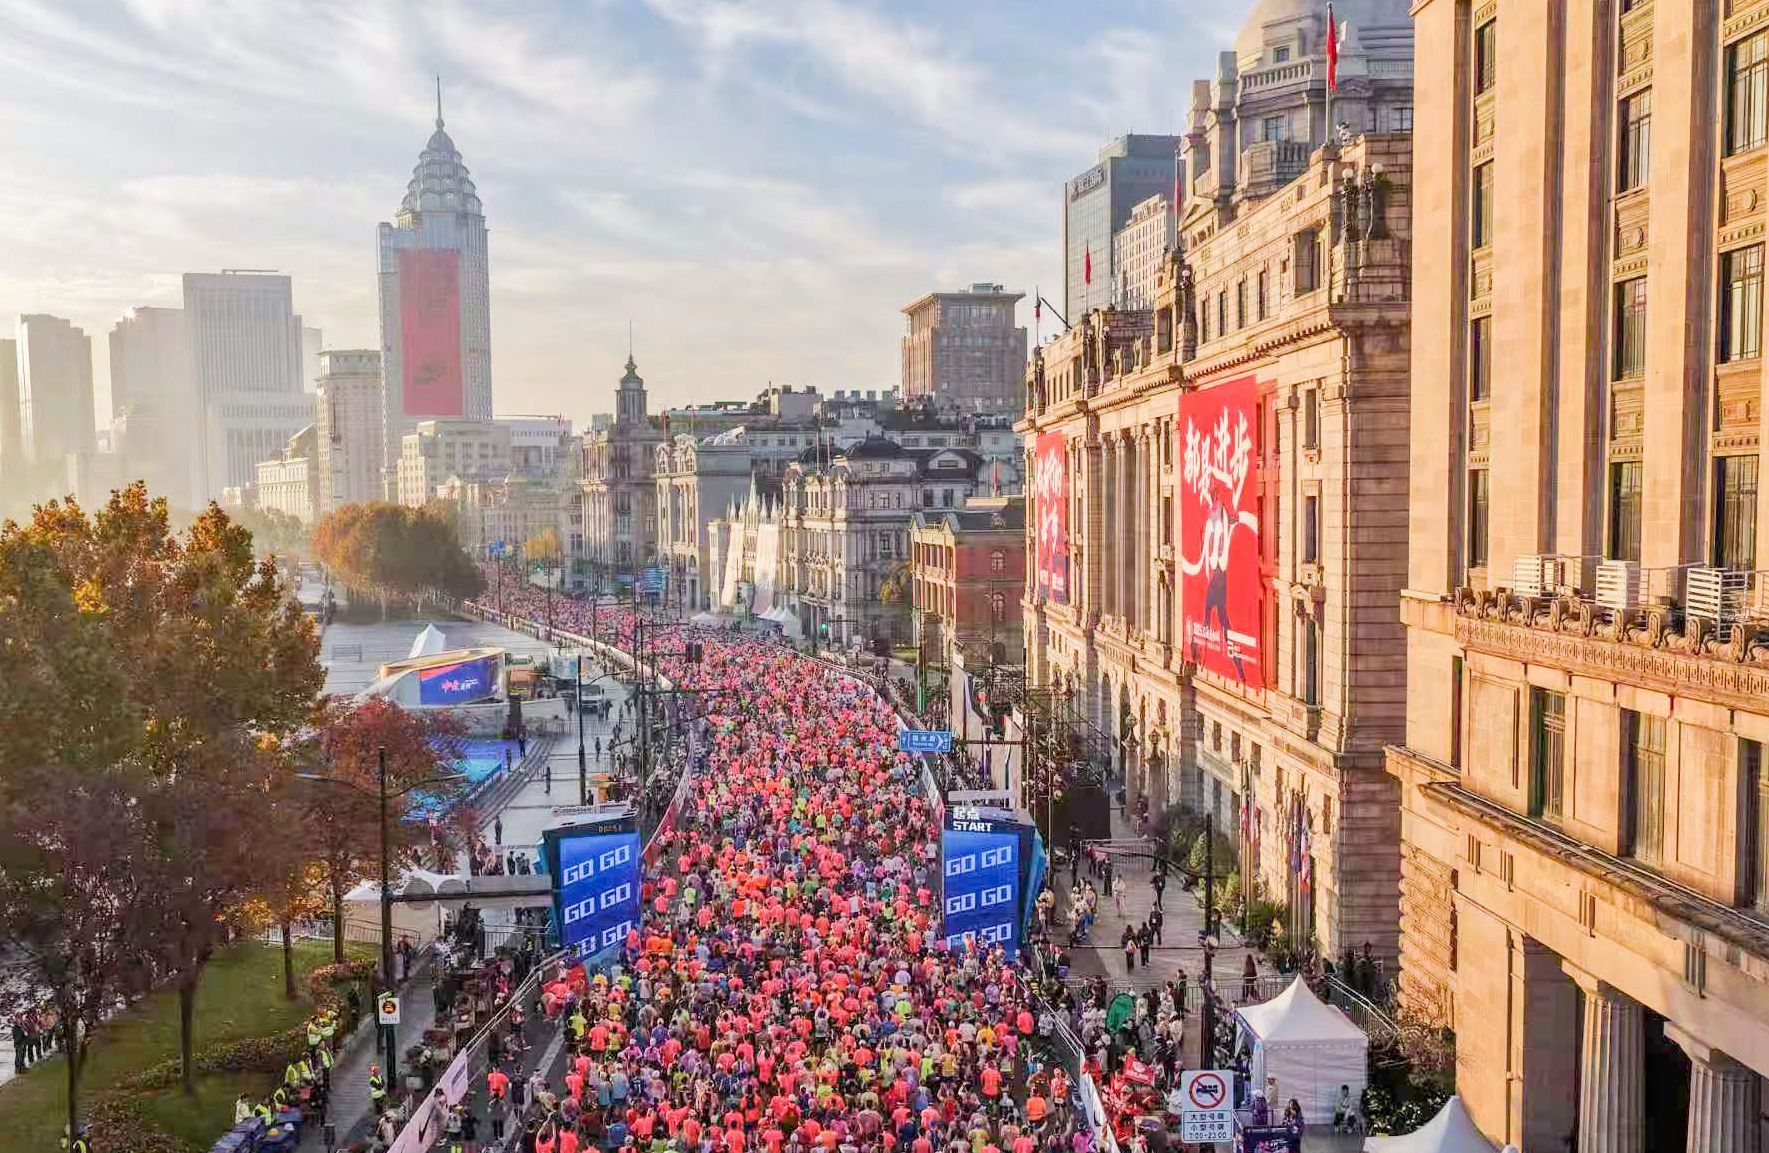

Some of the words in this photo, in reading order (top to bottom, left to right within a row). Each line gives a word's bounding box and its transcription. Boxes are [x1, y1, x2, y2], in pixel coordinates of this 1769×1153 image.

[953, 805, 980, 820] 起点
[953, 821, 993, 832] START
[563, 859, 594, 886] GO
[600, 845, 630, 872] GO
[946, 853, 976, 877] GO
[981, 845, 1012, 869] GO
[564, 897, 595, 925] GO
[601, 882, 631, 910] GO
[946, 892, 976, 915] GO
[981, 884, 1012, 907] GO
[602, 920, 632, 947] GO
